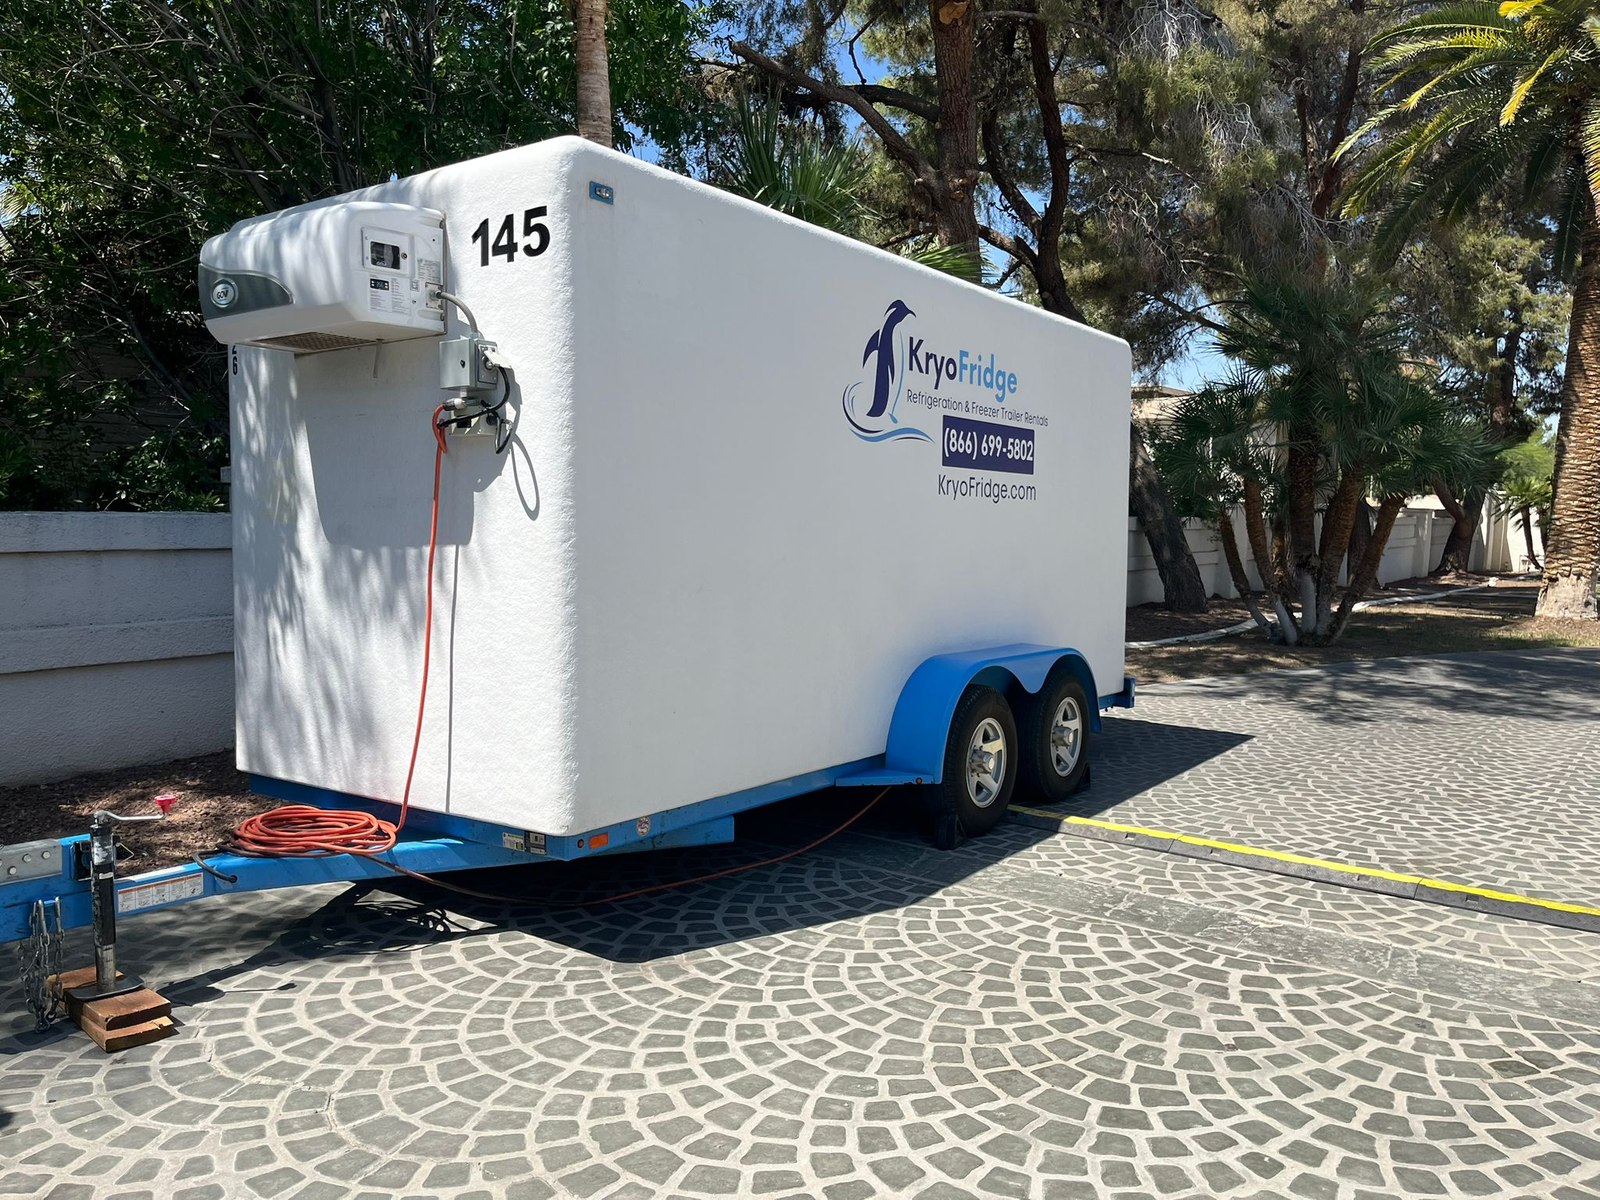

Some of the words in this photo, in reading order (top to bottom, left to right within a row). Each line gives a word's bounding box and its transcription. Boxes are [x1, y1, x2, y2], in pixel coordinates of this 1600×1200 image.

[471, 205, 551, 267] 145
[908, 336, 1018, 403] KryoFridge
[907, 389, 963, 412] Refrigeration
[964, 400, 970, 413] &
[971, 401, 1000, 418] Freezer
[1000, 407, 1024, 422] Trailer
[1024, 412, 1049, 427] Rentals
[944, 427, 978, 460] (866)
[981, 434, 1034, 461] 699-5802
[938, 474, 1037, 504] KryoFridge.com
